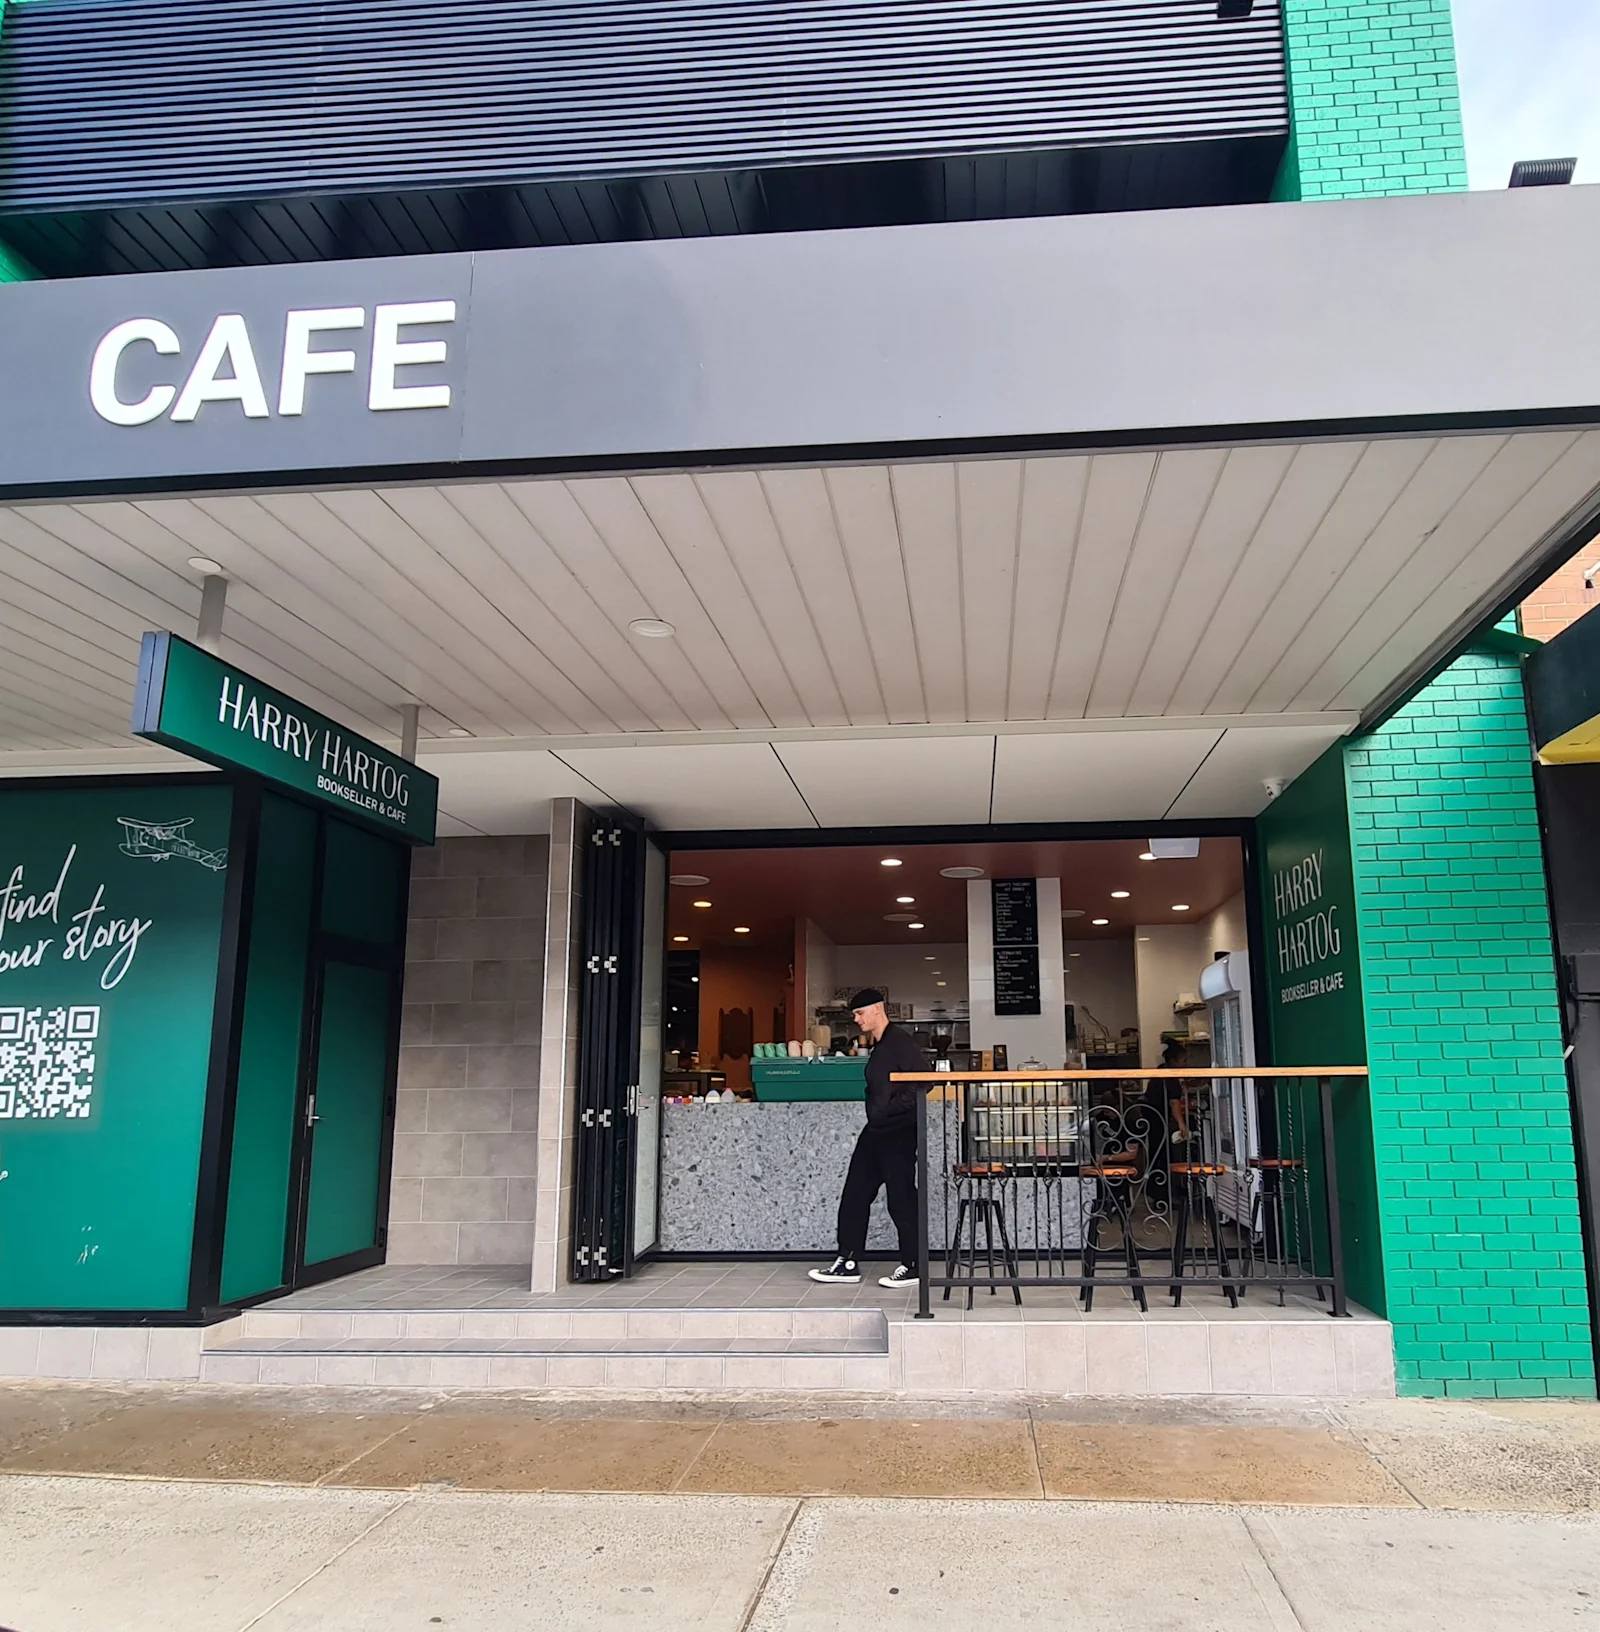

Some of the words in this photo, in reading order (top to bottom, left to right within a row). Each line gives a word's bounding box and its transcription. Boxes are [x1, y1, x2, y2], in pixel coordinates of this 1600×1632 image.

[89, 299, 456, 427] CAFE
[219, 676, 318, 761] HARRY
[322, 729, 409, 806] HARTOG
[316, 774, 378, 812] BOOKSELLER
[378, 802, 386, 815] &
[386, 805, 407, 824] CAFE
[0, 843, 77, 942] find
[1274, 848, 1323, 920] HARRY
[0, 938, 54, 973] our
[62, 883, 153, 990] story
[1277, 905, 1341, 974] HARTOG
[1281, 978, 1320, 1004] BOOKSELLER
[1319, 977, 1326, 994] &
[1325, 971, 1344, 993] CAFE
